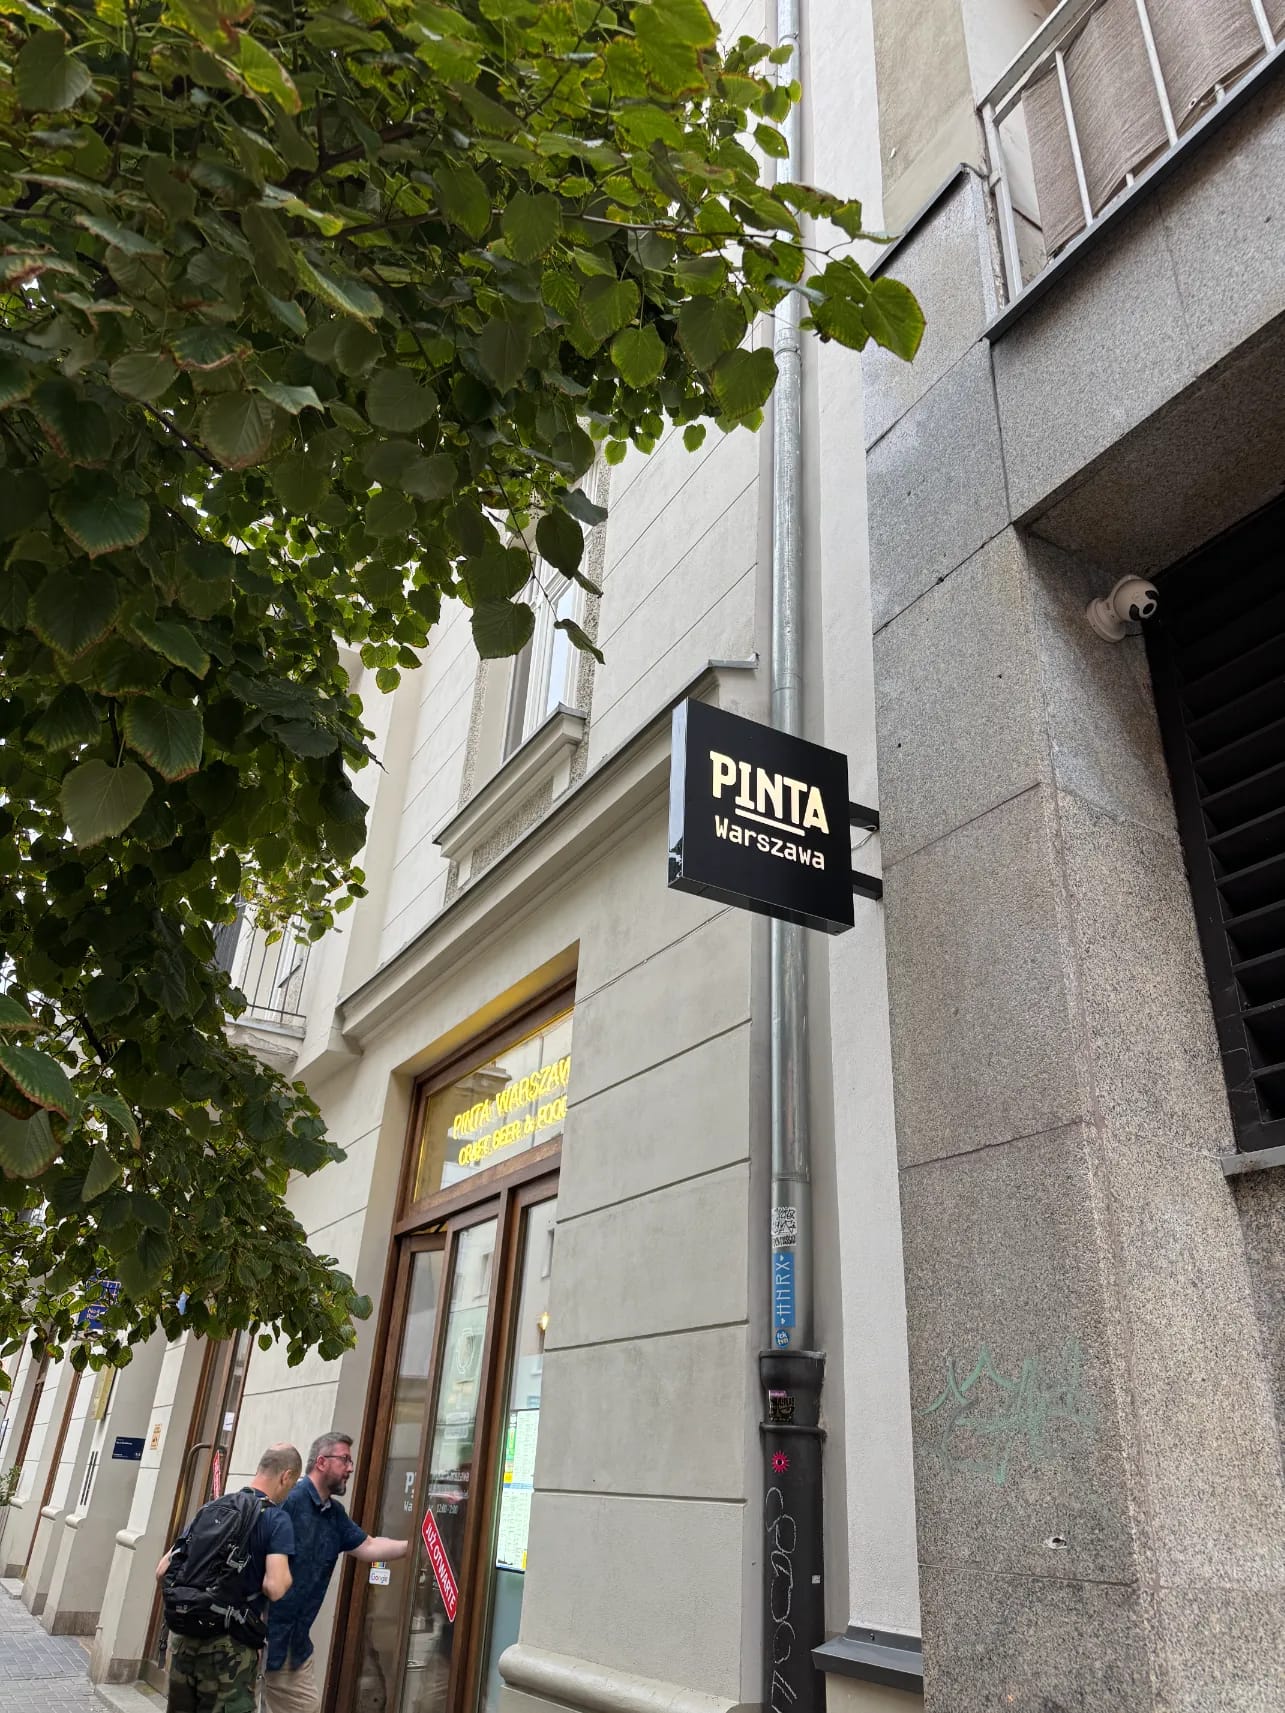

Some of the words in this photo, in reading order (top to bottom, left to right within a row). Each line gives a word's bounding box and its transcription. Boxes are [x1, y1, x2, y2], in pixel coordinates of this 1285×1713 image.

[709, 750, 830, 835] PINTA
[714, 814, 825, 871] Warszawa
[452, 1098, 490, 1139] PINTA
[492, 1119, 522, 1150] BEER
[433, 1545, 457, 1611] OTWARTE
